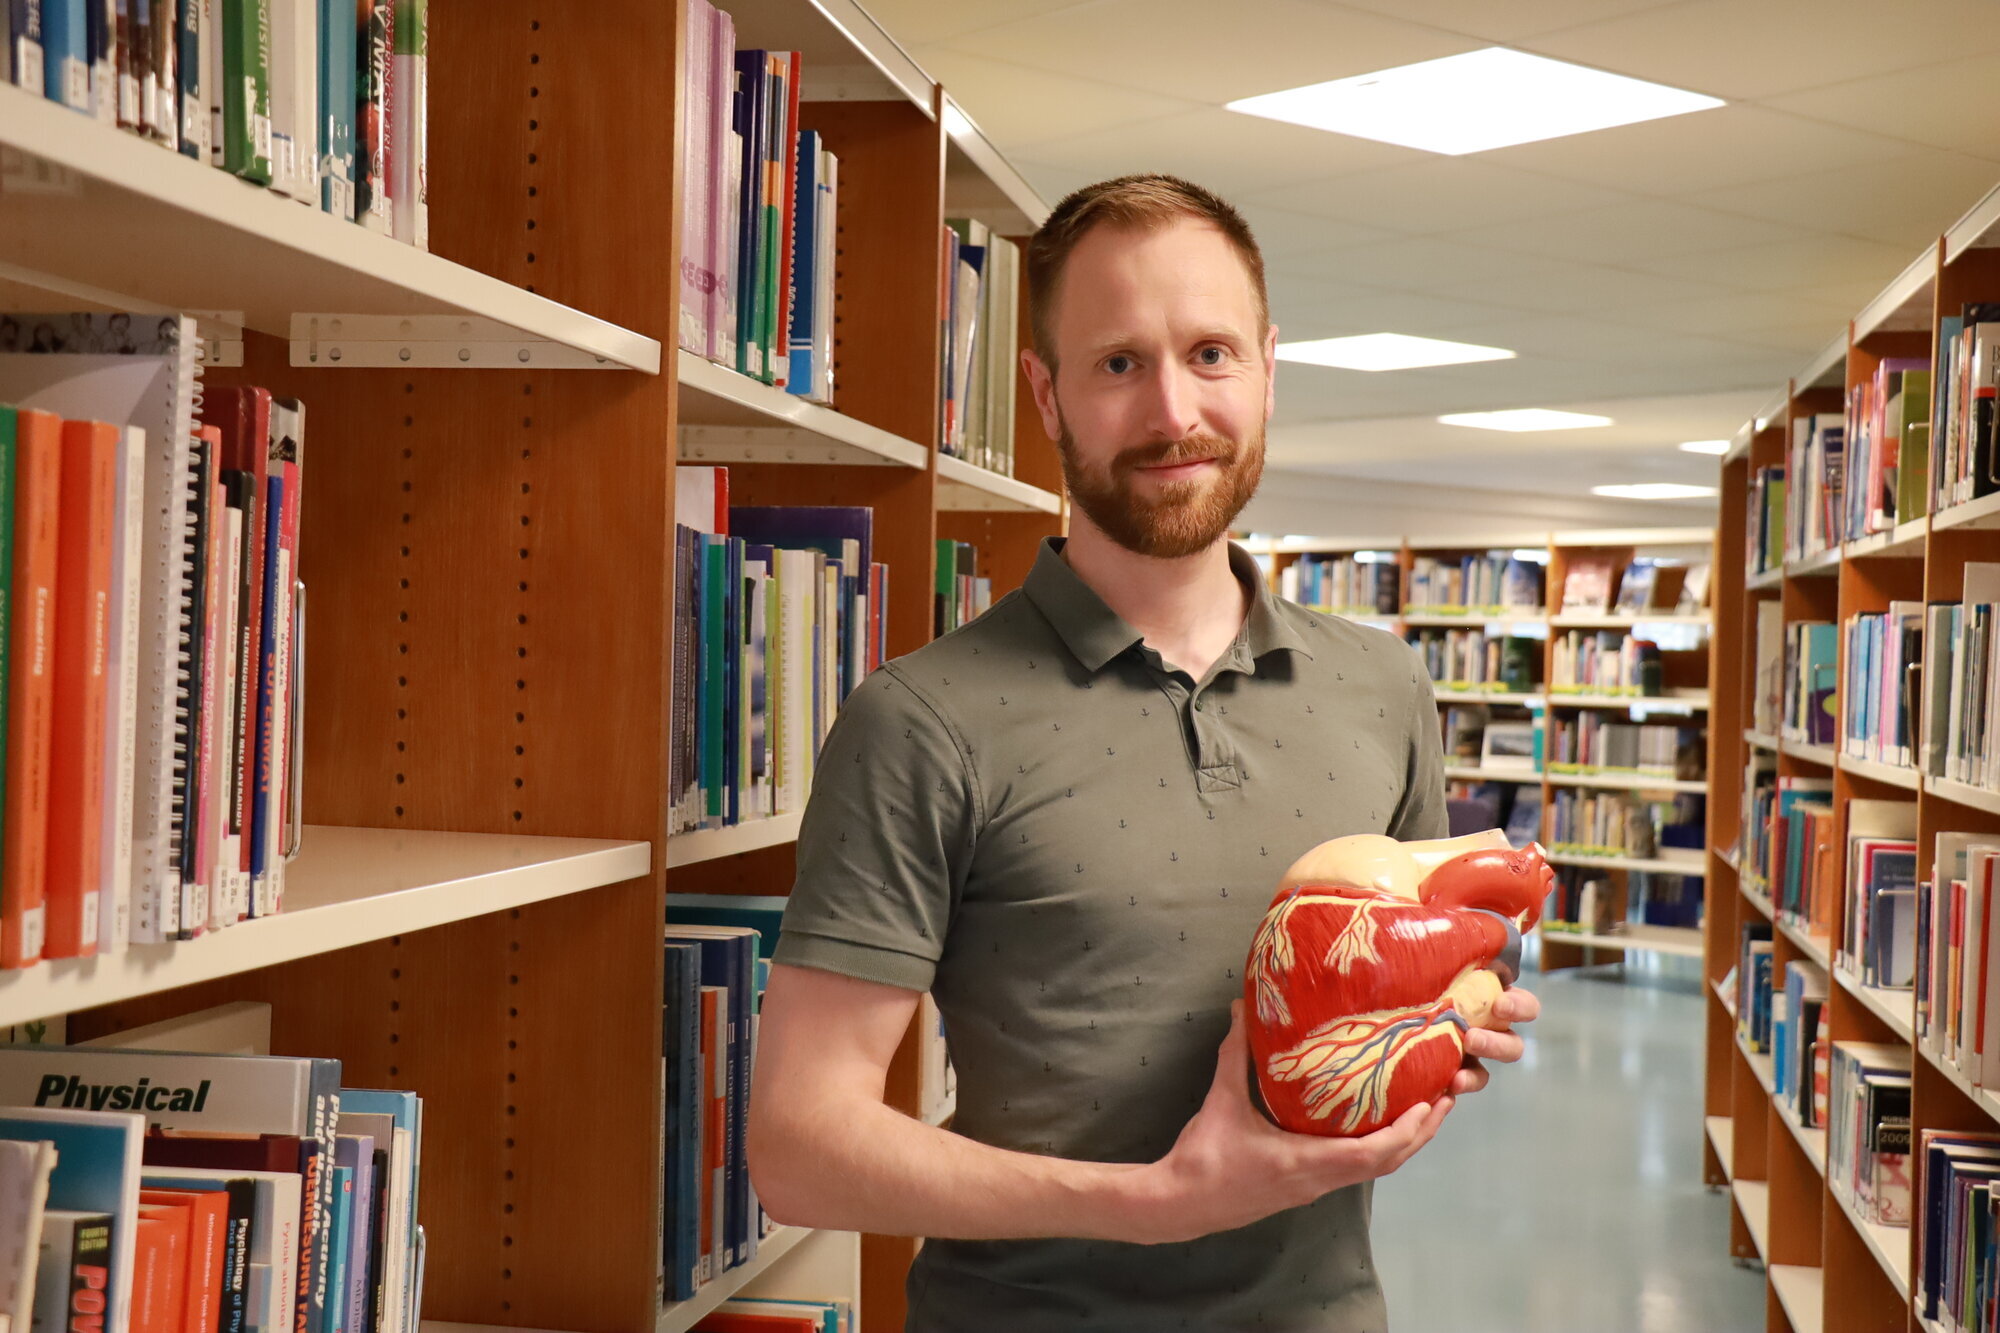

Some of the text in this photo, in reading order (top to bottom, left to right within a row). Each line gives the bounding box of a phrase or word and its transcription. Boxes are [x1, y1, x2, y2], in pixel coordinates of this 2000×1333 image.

[34, 1074, 211, 1115] Physical
[314, 1095, 327, 1145] and
[313, 1093, 341, 1309] Physical Activity
[225, 1219, 237, 1292] 2nd Edition
[233, 1218, 249, 1291] Psychology
[232, 1293, 242, 1307] of
